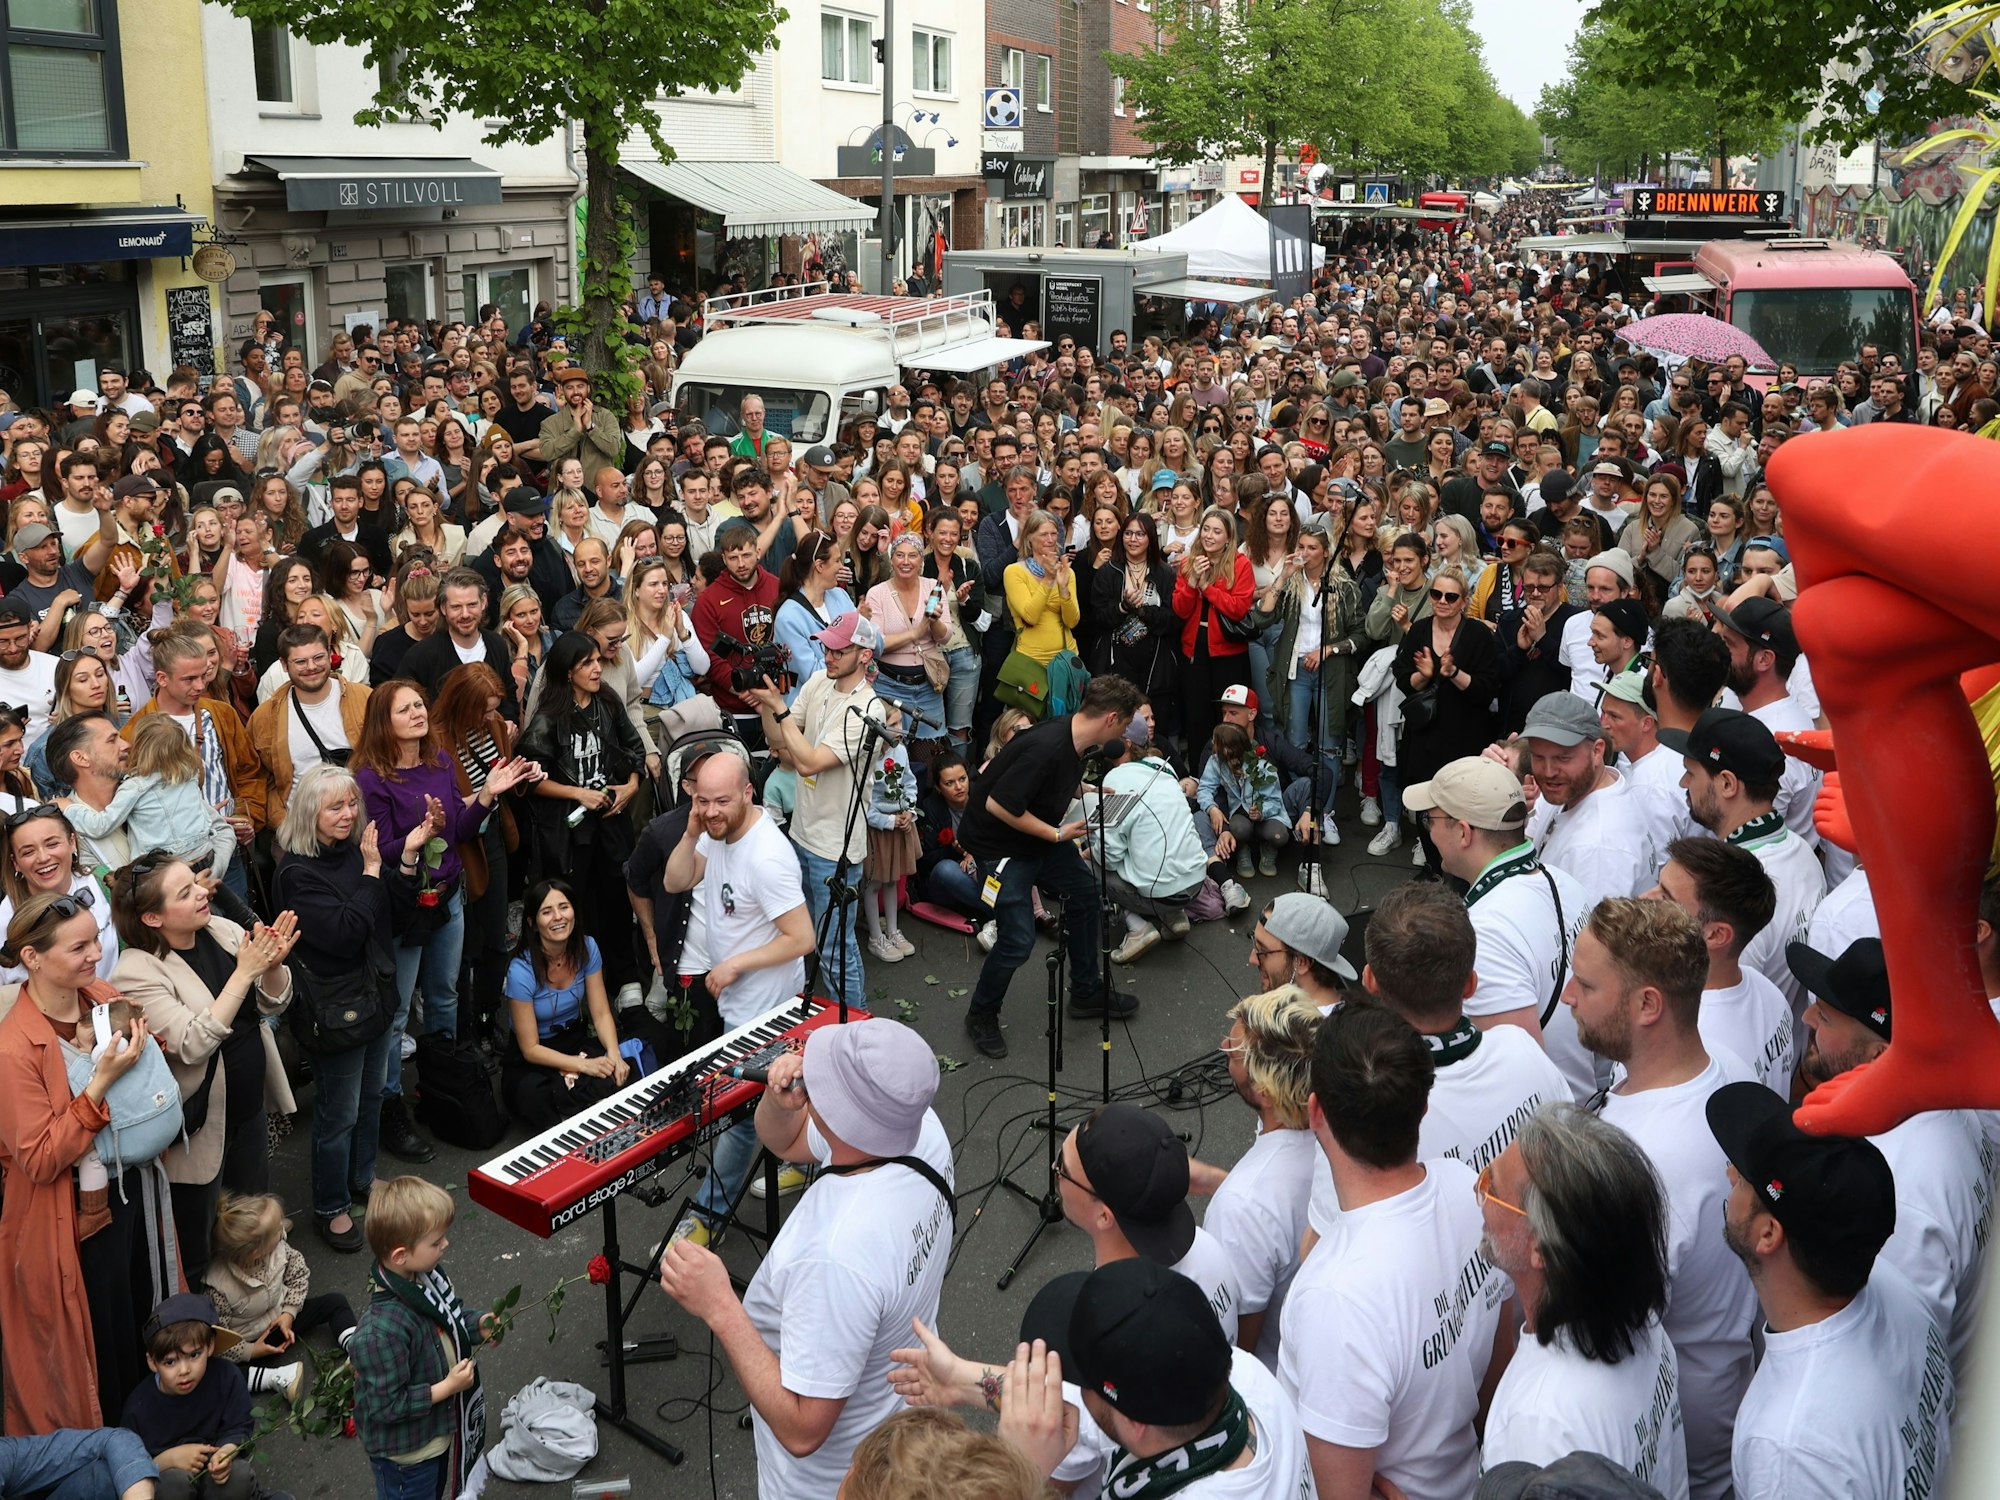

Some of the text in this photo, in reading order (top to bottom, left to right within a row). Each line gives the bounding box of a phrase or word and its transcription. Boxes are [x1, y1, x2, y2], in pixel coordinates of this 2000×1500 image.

[985, 157, 1009, 173] sky
[366, 181, 464, 205] STILVOLL
[1656, 192, 1760, 213] BRENNWERK
[1509, 790, 1521, 799] POLO
[551, 1198, 586, 1230] nord
[635, 1159, 657, 1180] EX
[911, 1218, 925, 1244] DIE
[1433, 1288, 1451, 1319] DIE
[1634, 1411, 1649, 1446] DIE
[1900, 1414, 1918, 1450] DIE
